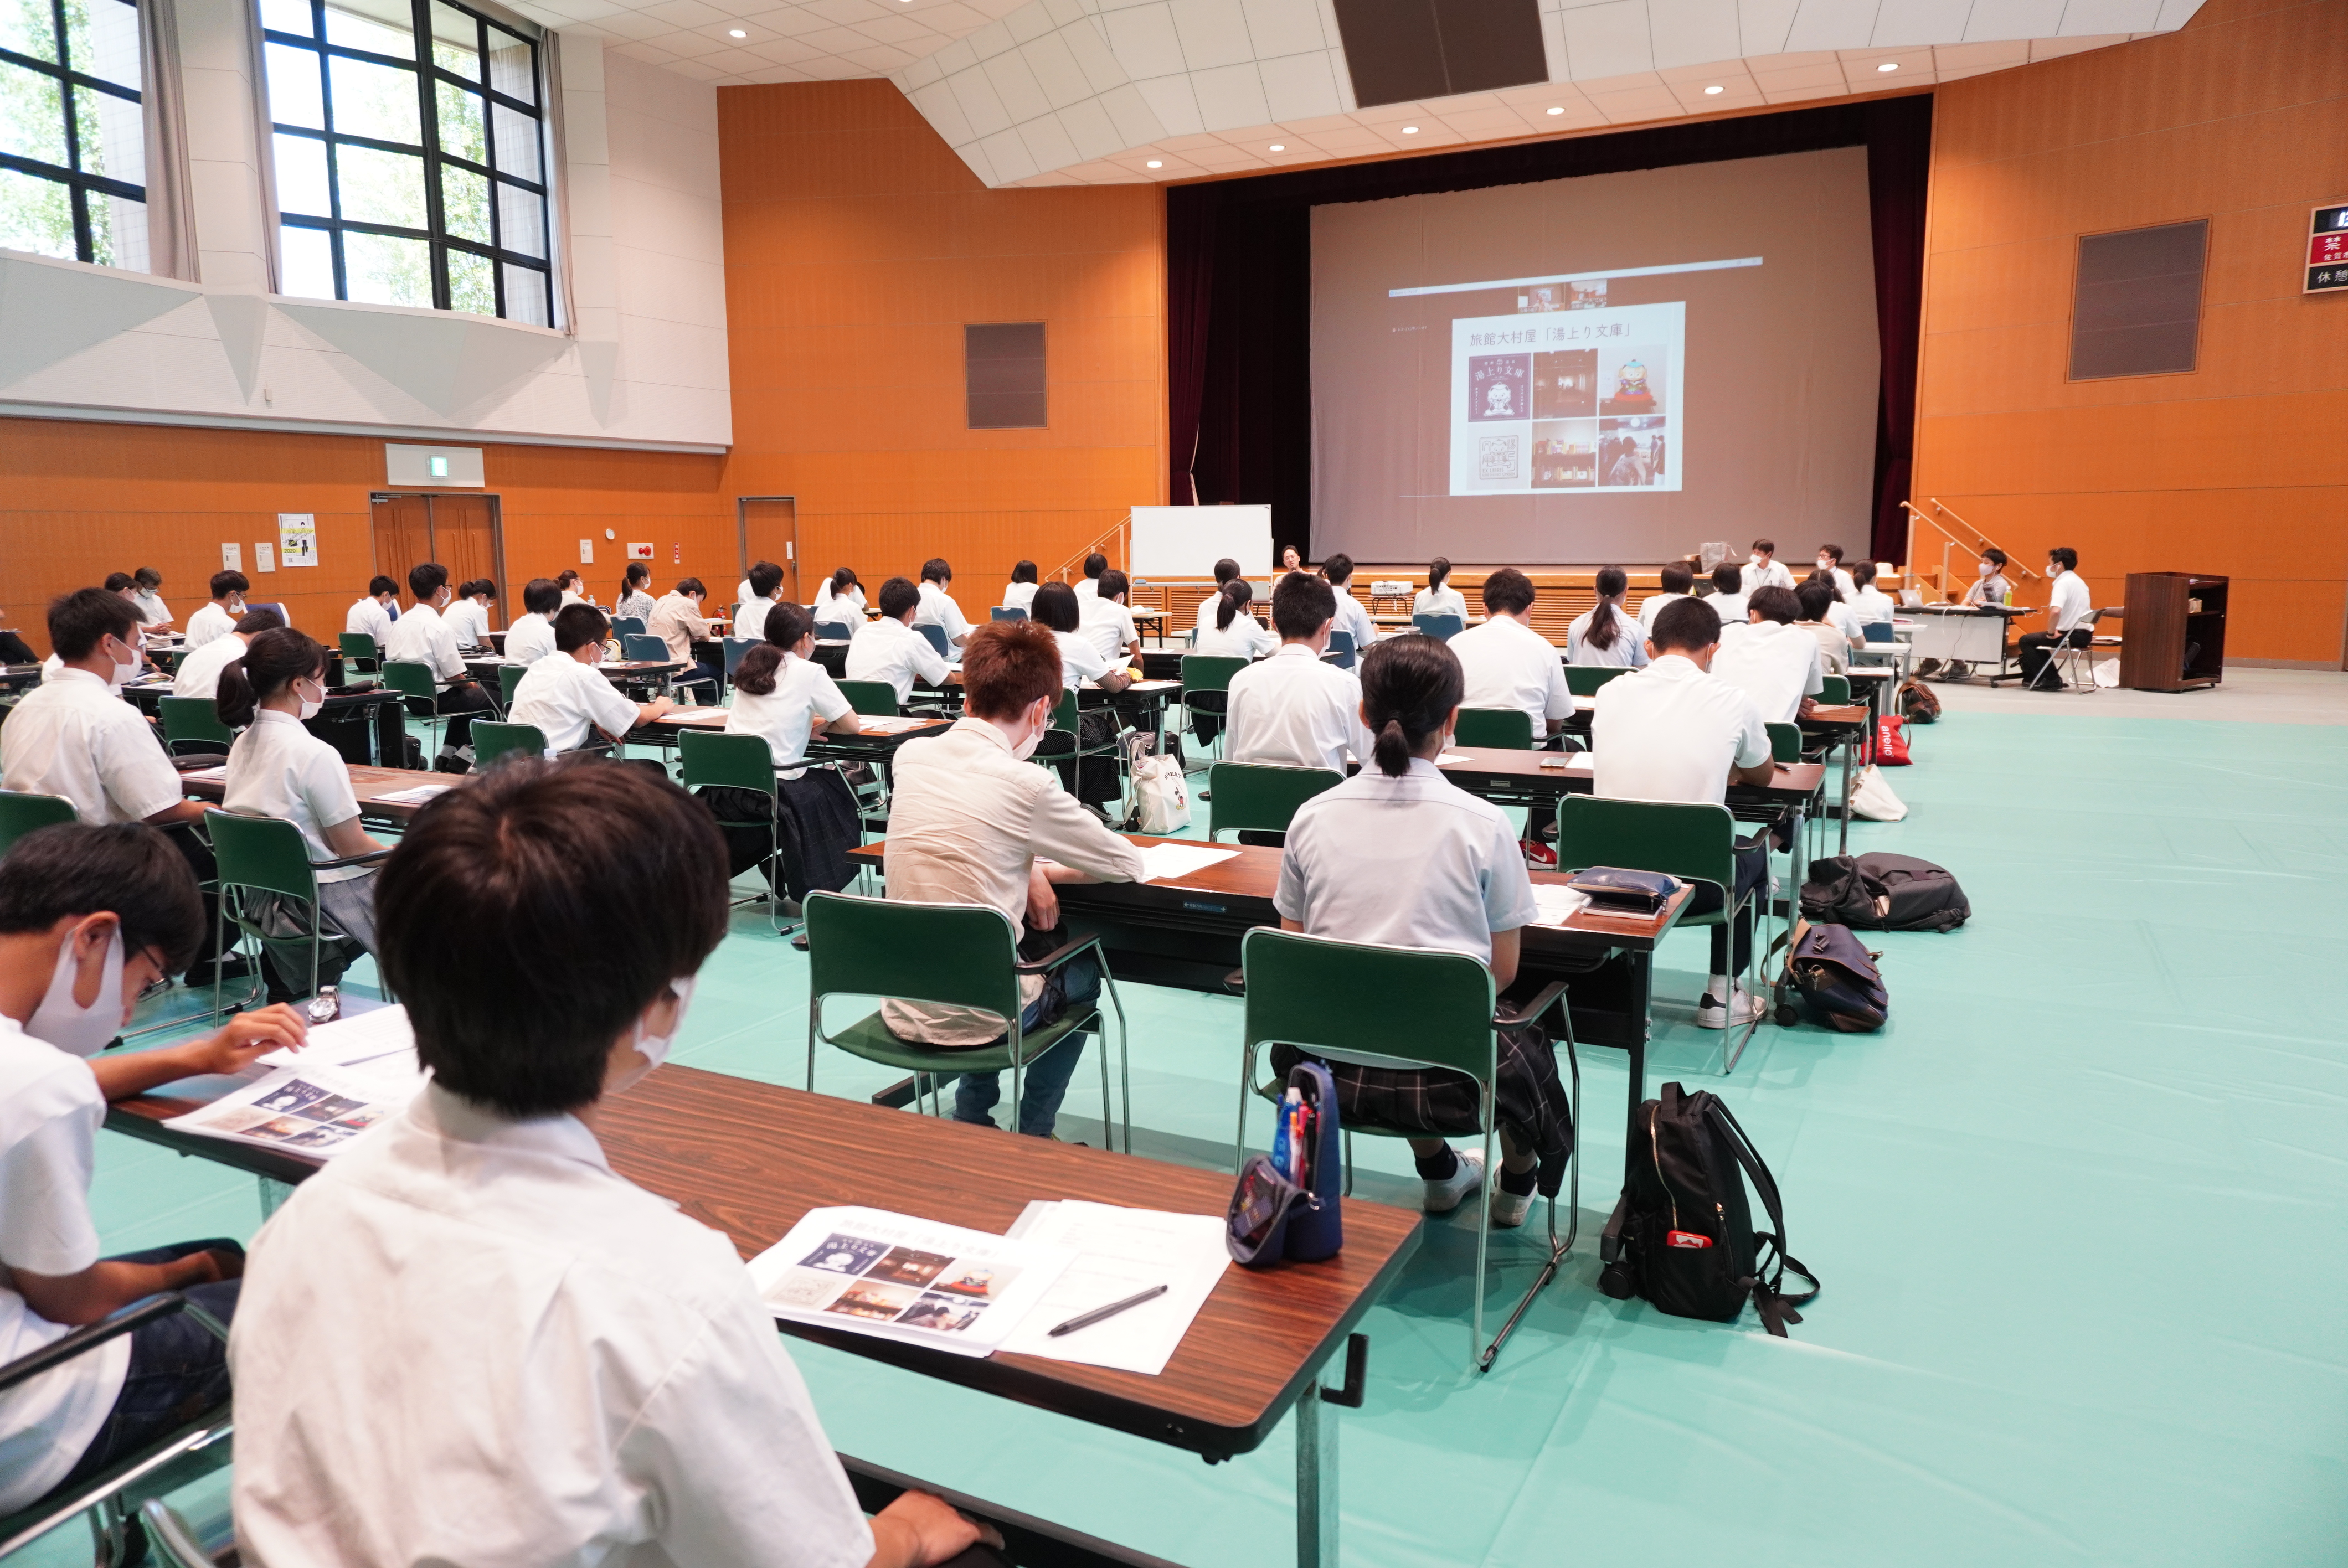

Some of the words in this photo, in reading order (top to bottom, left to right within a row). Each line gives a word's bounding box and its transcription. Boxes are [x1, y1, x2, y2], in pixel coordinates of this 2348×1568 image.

[1470, 323, 1630, 347] 旅館大村屋「湯上り文庫」
[1475, 365, 1525, 381] 湯上り文庫
[1881, 725, 1893, 756] anello
